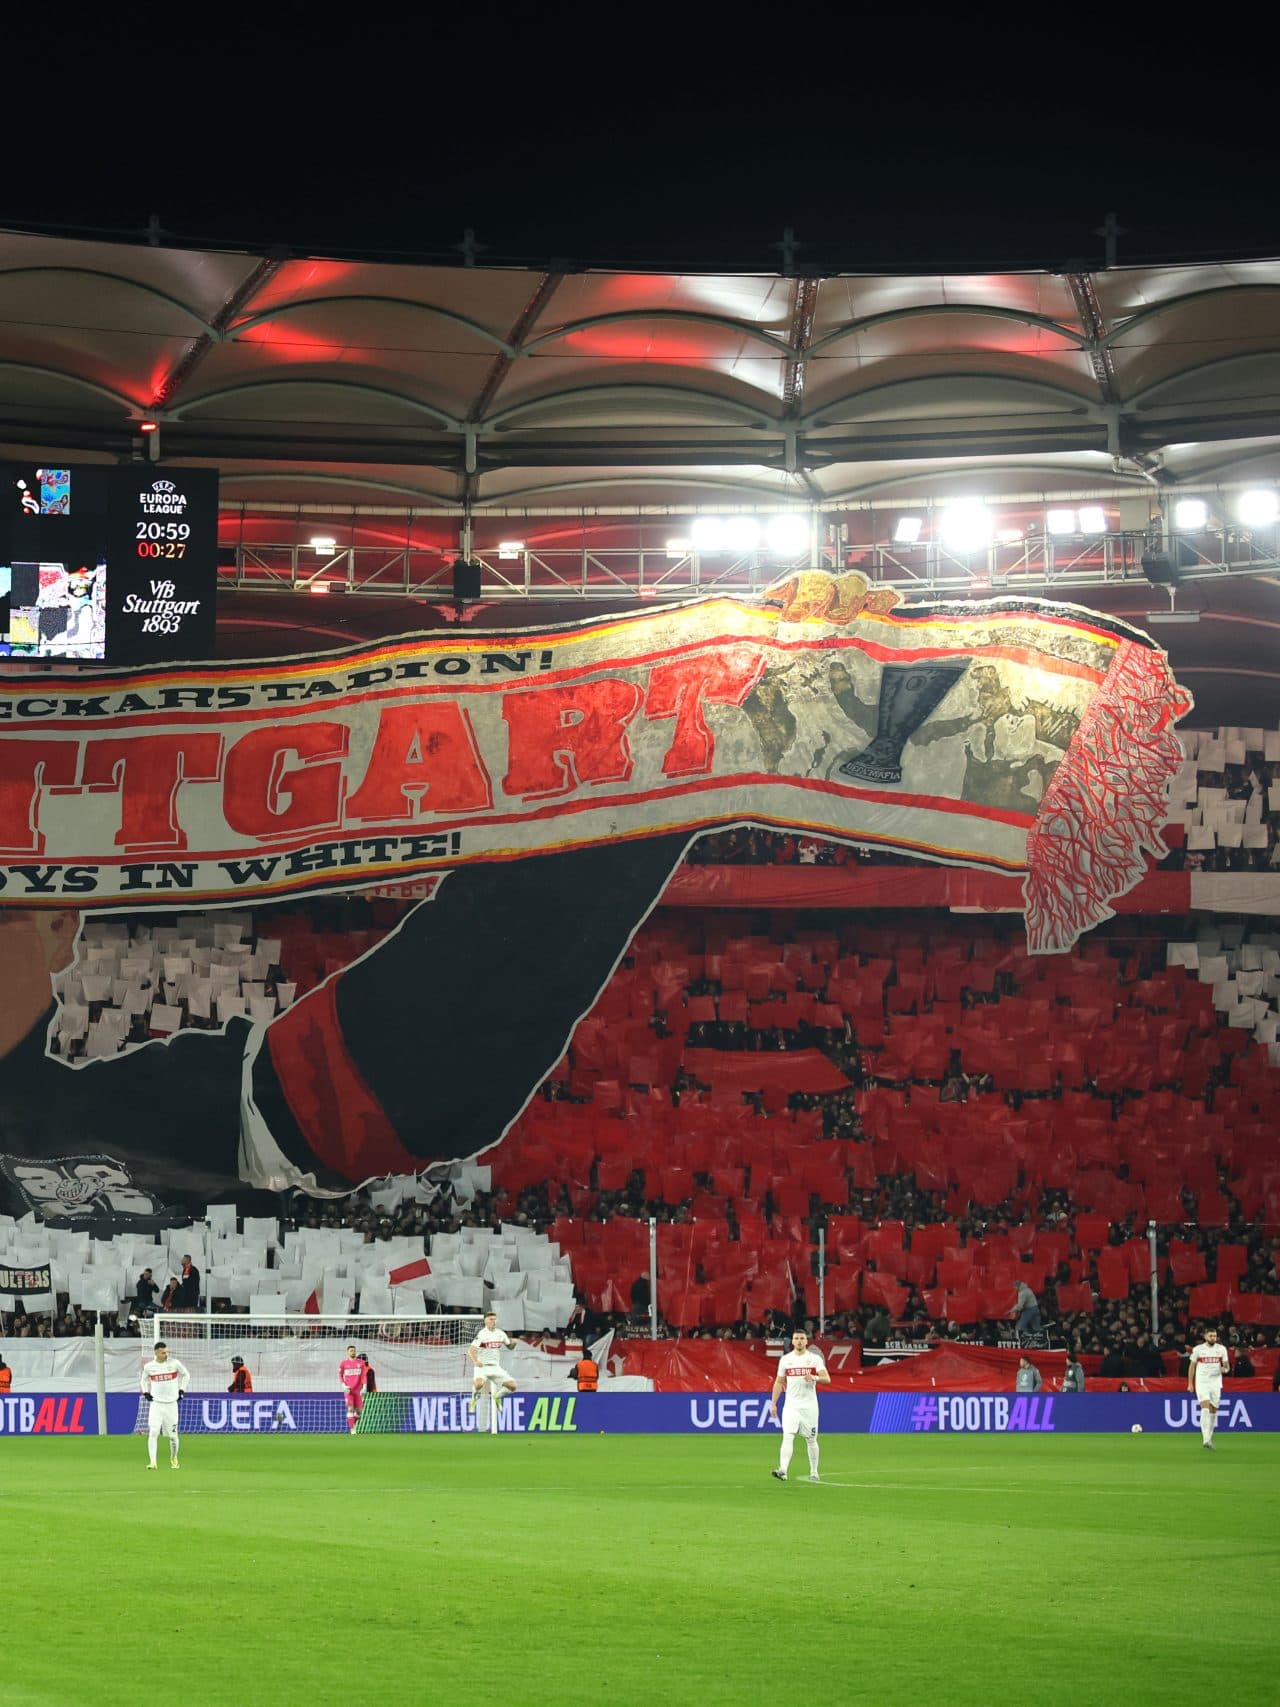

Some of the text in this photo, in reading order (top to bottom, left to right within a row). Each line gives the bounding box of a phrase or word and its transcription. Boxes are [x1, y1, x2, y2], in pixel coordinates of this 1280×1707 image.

[152, 481, 176, 492] UEFA
[140, 493, 187, 505] EUROPA
[143, 504, 183, 514] LEAGUE
[136, 522, 190, 540] 20:59
[138, 542, 186, 559] 00:27
[150, 580, 176, 600] VfB
[122, 594, 200, 619] Stuttgart
[141, 615, 181, 634] 1893
[119, 863, 199, 890] IN
[217, 832, 462, 885] WHITE!
[0, 1270, 50, 1289] ULTRAS
[202, 1399, 297, 1430] UEFA
[528, 1397, 577, 1432] ALL
[691, 1399, 782, 1429] UEFA
[912, 1397, 1055, 1431] #FOOTBALL
[1164, 1399, 1253, 1428] UEFA
